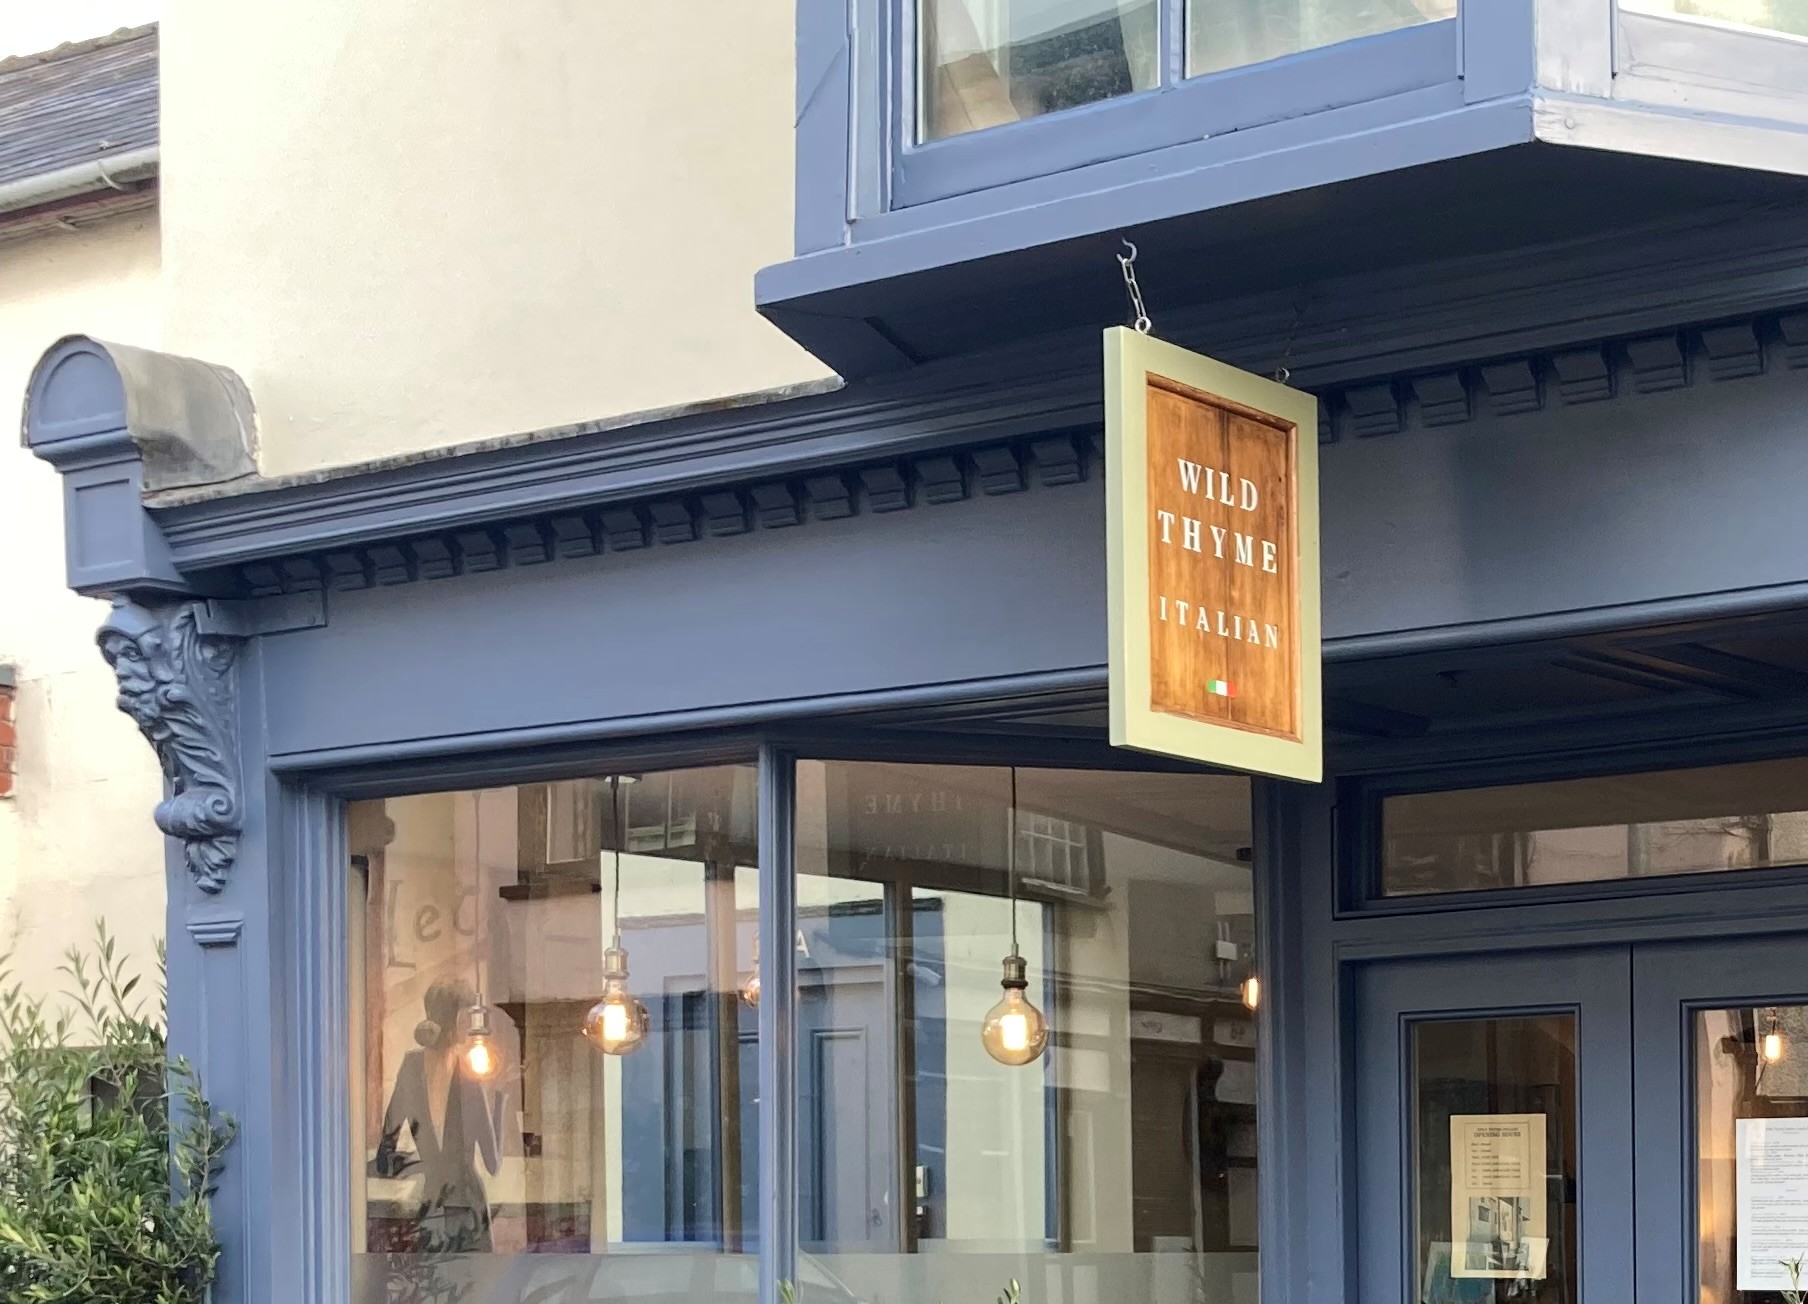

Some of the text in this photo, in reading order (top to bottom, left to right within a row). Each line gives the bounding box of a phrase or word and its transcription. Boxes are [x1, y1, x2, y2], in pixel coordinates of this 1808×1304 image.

[1176, 457, 1259, 512] WILD
[1157, 508, 1278, 574] THYME
[1158, 595, 1279, 650] ITALIAN
